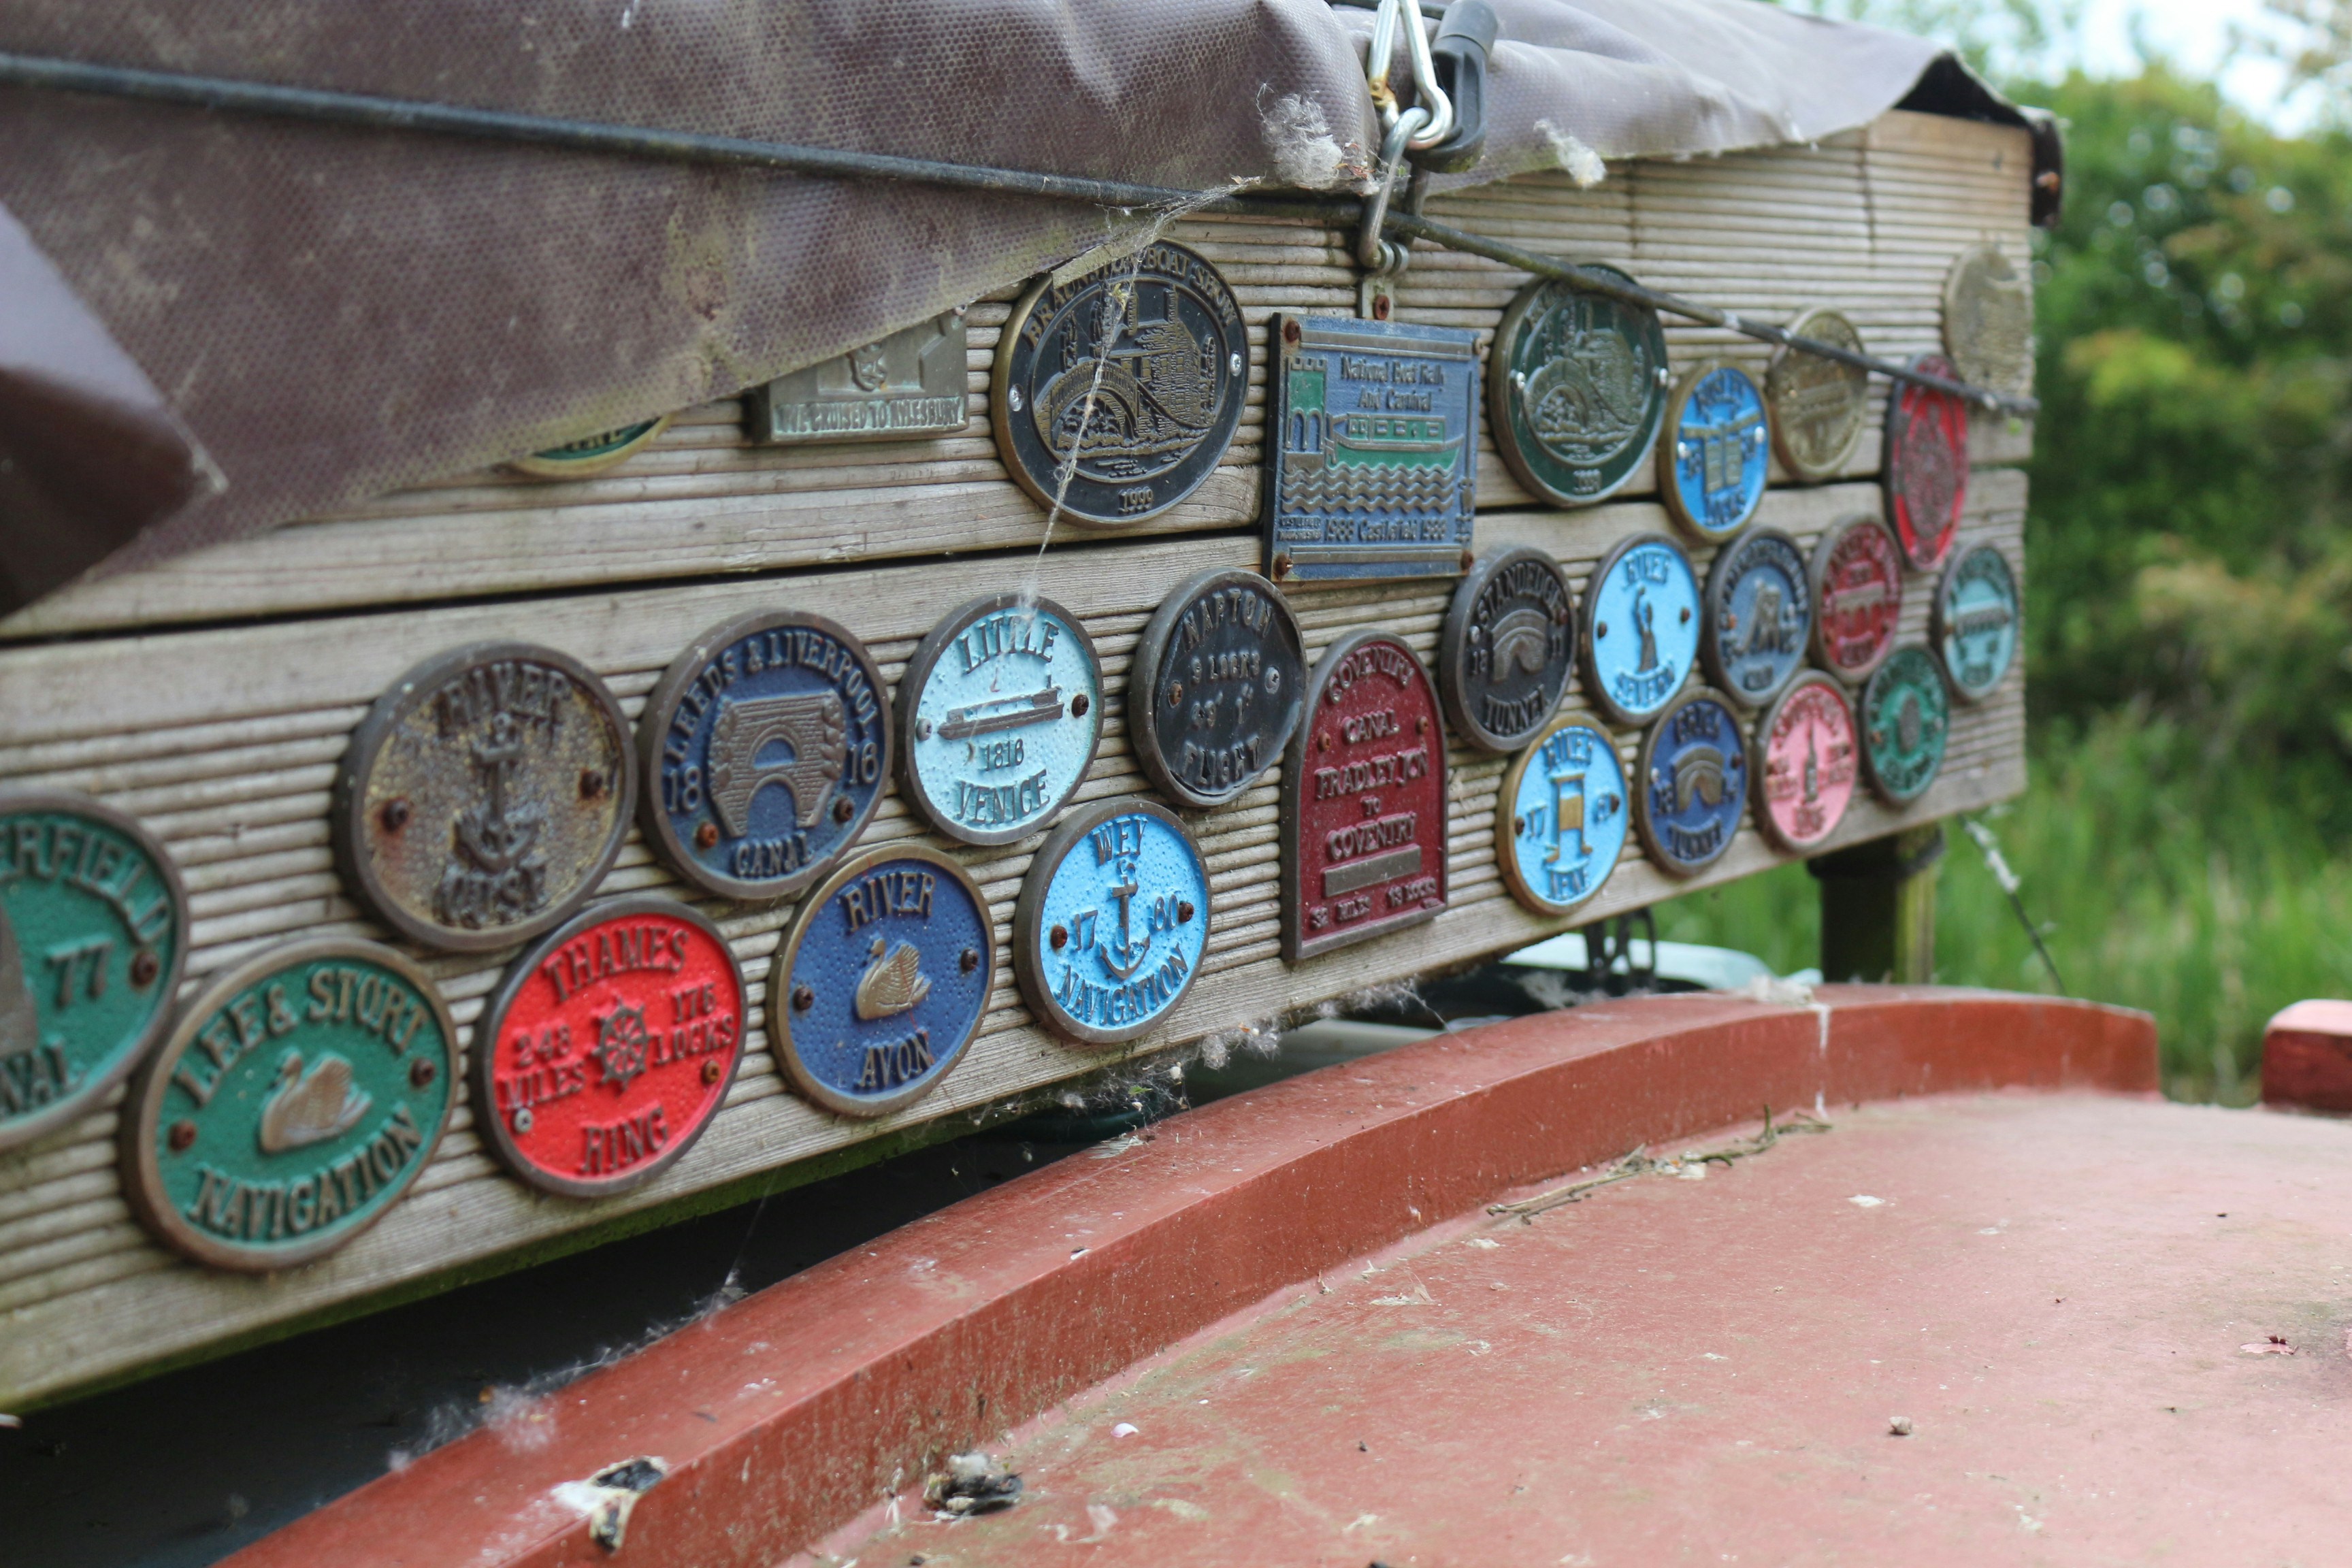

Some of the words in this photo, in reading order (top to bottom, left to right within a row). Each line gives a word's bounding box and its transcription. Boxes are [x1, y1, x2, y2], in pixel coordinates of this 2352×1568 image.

[1145, 245, 1191, 280] BOAT
[1192, 264, 1237, 327] SHOW
[1340, 355, 1389, 384] National
[1392, 360, 1418, 385] Boat
[867, 398, 889, 429] TO
[1357, 387, 1382, 410] And
[1386, 388, 1433, 412] Carnival
[1358, 517, 1418, 542] Castlefield
[1622, 550, 1671, 590] RIVER
[1183, 587, 1274, 646] NAPTON
[961, 614, 1059, 674] LITTLE
[1207, 650, 1260, 681] LOCKS
[664, 650, 737, 762] LEEDS
[747, 638, 763, 672] &
[767, 630, 879, 728] LIVERPOOL
[1326, 646, 1416, 704] COVENTRY
[1343, 707, 1401, 745] CANAL
[1485, 683, 1552, 736] TUNNEL
[849, 741, 879, 786] 16
[1181, 734, 1260, 785] FLIGHT
[1541, 725, 1595, 773] RIVER
[668, 766, 702, 813] 18
[957, 768, 1051, 824] VENICE
[1315, 753, 1396, 800] FRADLEY
[1362, 795, 1382, 817] TO
[733, 830, 816, 878] CANAL
[1092, 817, 1149, 866] WEY
[1326, 811, 1417, 862] COVENTRY
[1667, 815, 1724, 859] TUNNEL
[842, 871, 937, 934] RIVER
[1335, 895, 1371, 923] MILES
[1403, 876, 1437, 902] LOCKS
[1073, 909, 1098, 952] 17
[45, 938, 113, 1011] 77
[545, 927, 691, 1002] THAMES
[1057, 943, 1190, 1026] NAVIGATION
[672, 981, 717, 1022] 176
[173, 994, 266, 1107] LEE
[266, 983, 298, 1035] &
[308, 967, 429, 1054] STORT
[655, 1013, 735, 1066] LOCKS
[859, 1030, 935, 1089] AVON
[502, 1060, 587, 1110] MILES
[580, 1105, 670, 1174] RING
[186, 1105, 425, 1241] NAVIGATION
